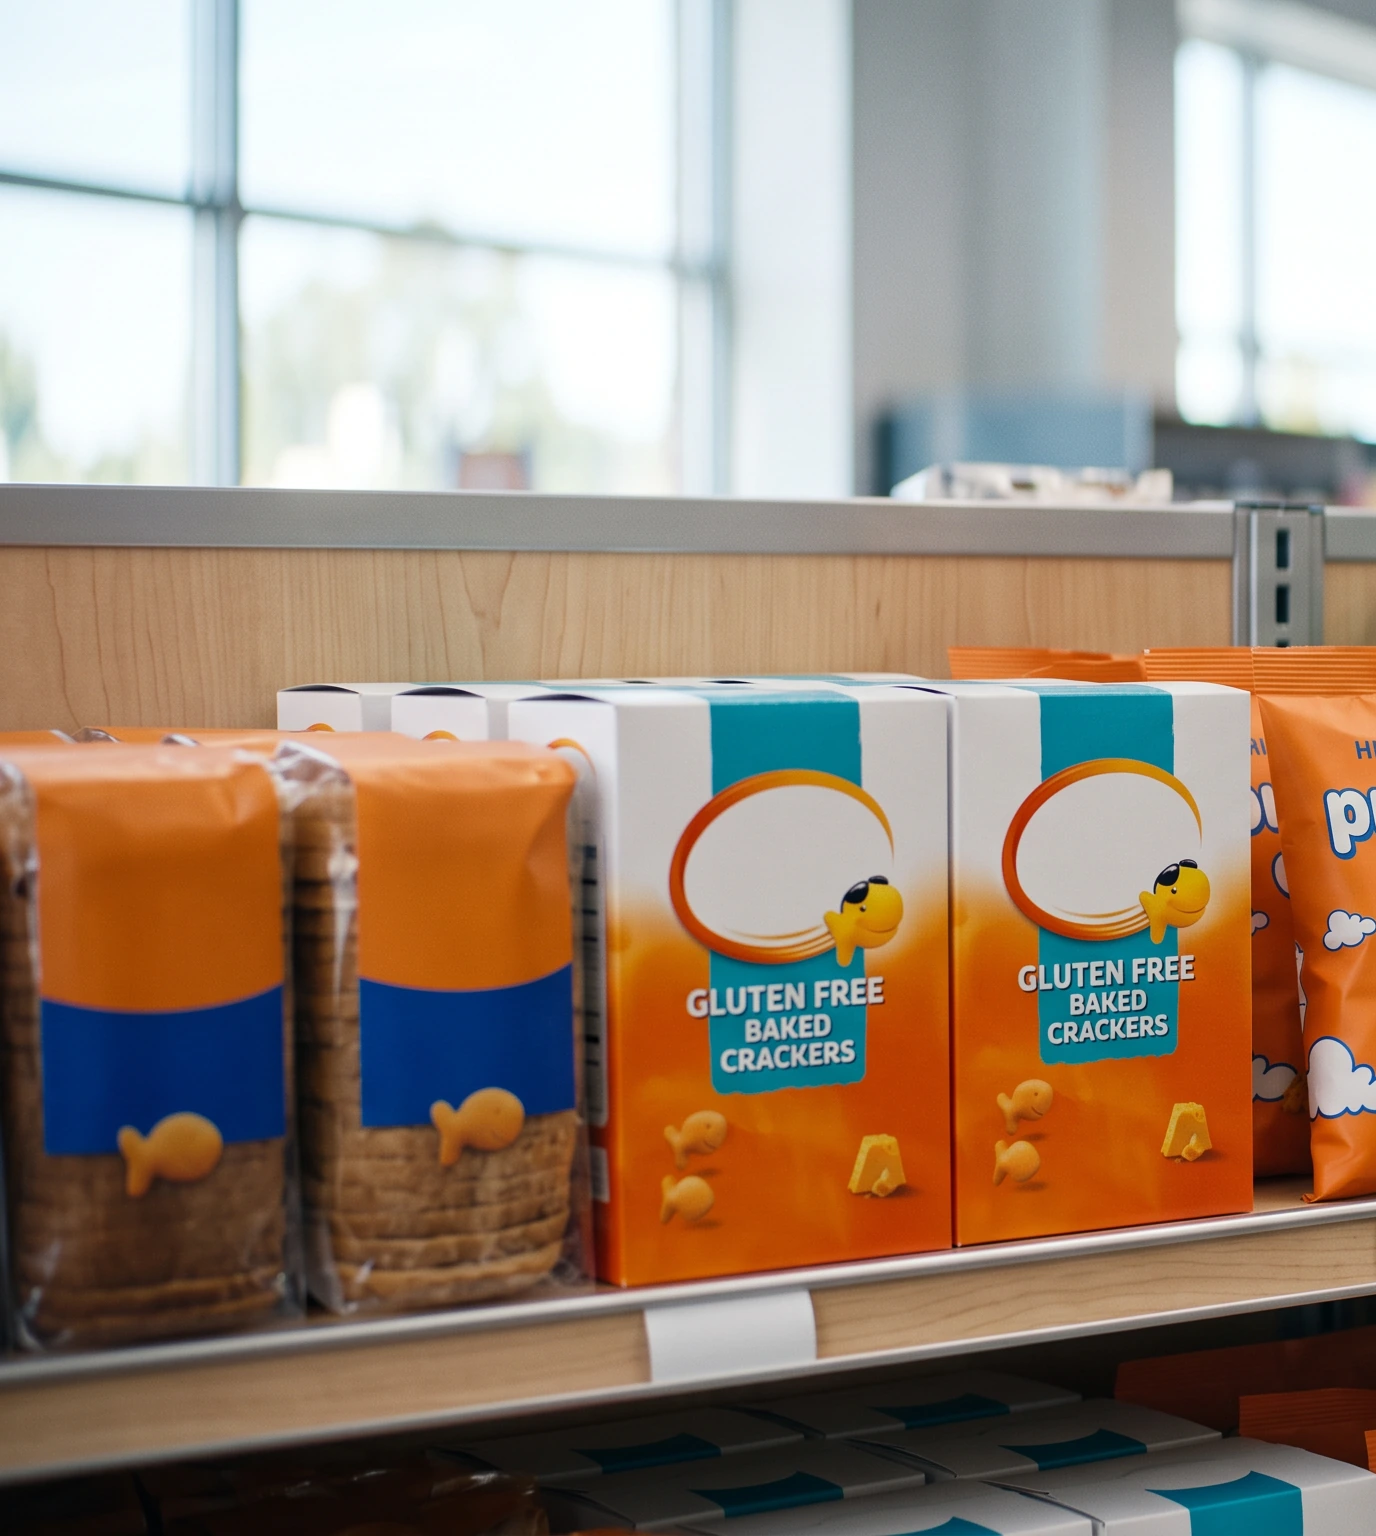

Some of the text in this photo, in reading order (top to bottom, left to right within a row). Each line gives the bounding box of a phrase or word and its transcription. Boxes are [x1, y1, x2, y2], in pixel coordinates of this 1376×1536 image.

[1017, 955, 1196, 992] GLUTEN FREE
[686, 976, 884, 1018] GLUTEN FREE
[1069, 989, 1147, 1016] BAKED
[744, 1013, 832, 1043] BAKED
[1047, 1014, 1169, 1044] CRACKERS
[720, 1039, 856, 1073] CRACKERS
